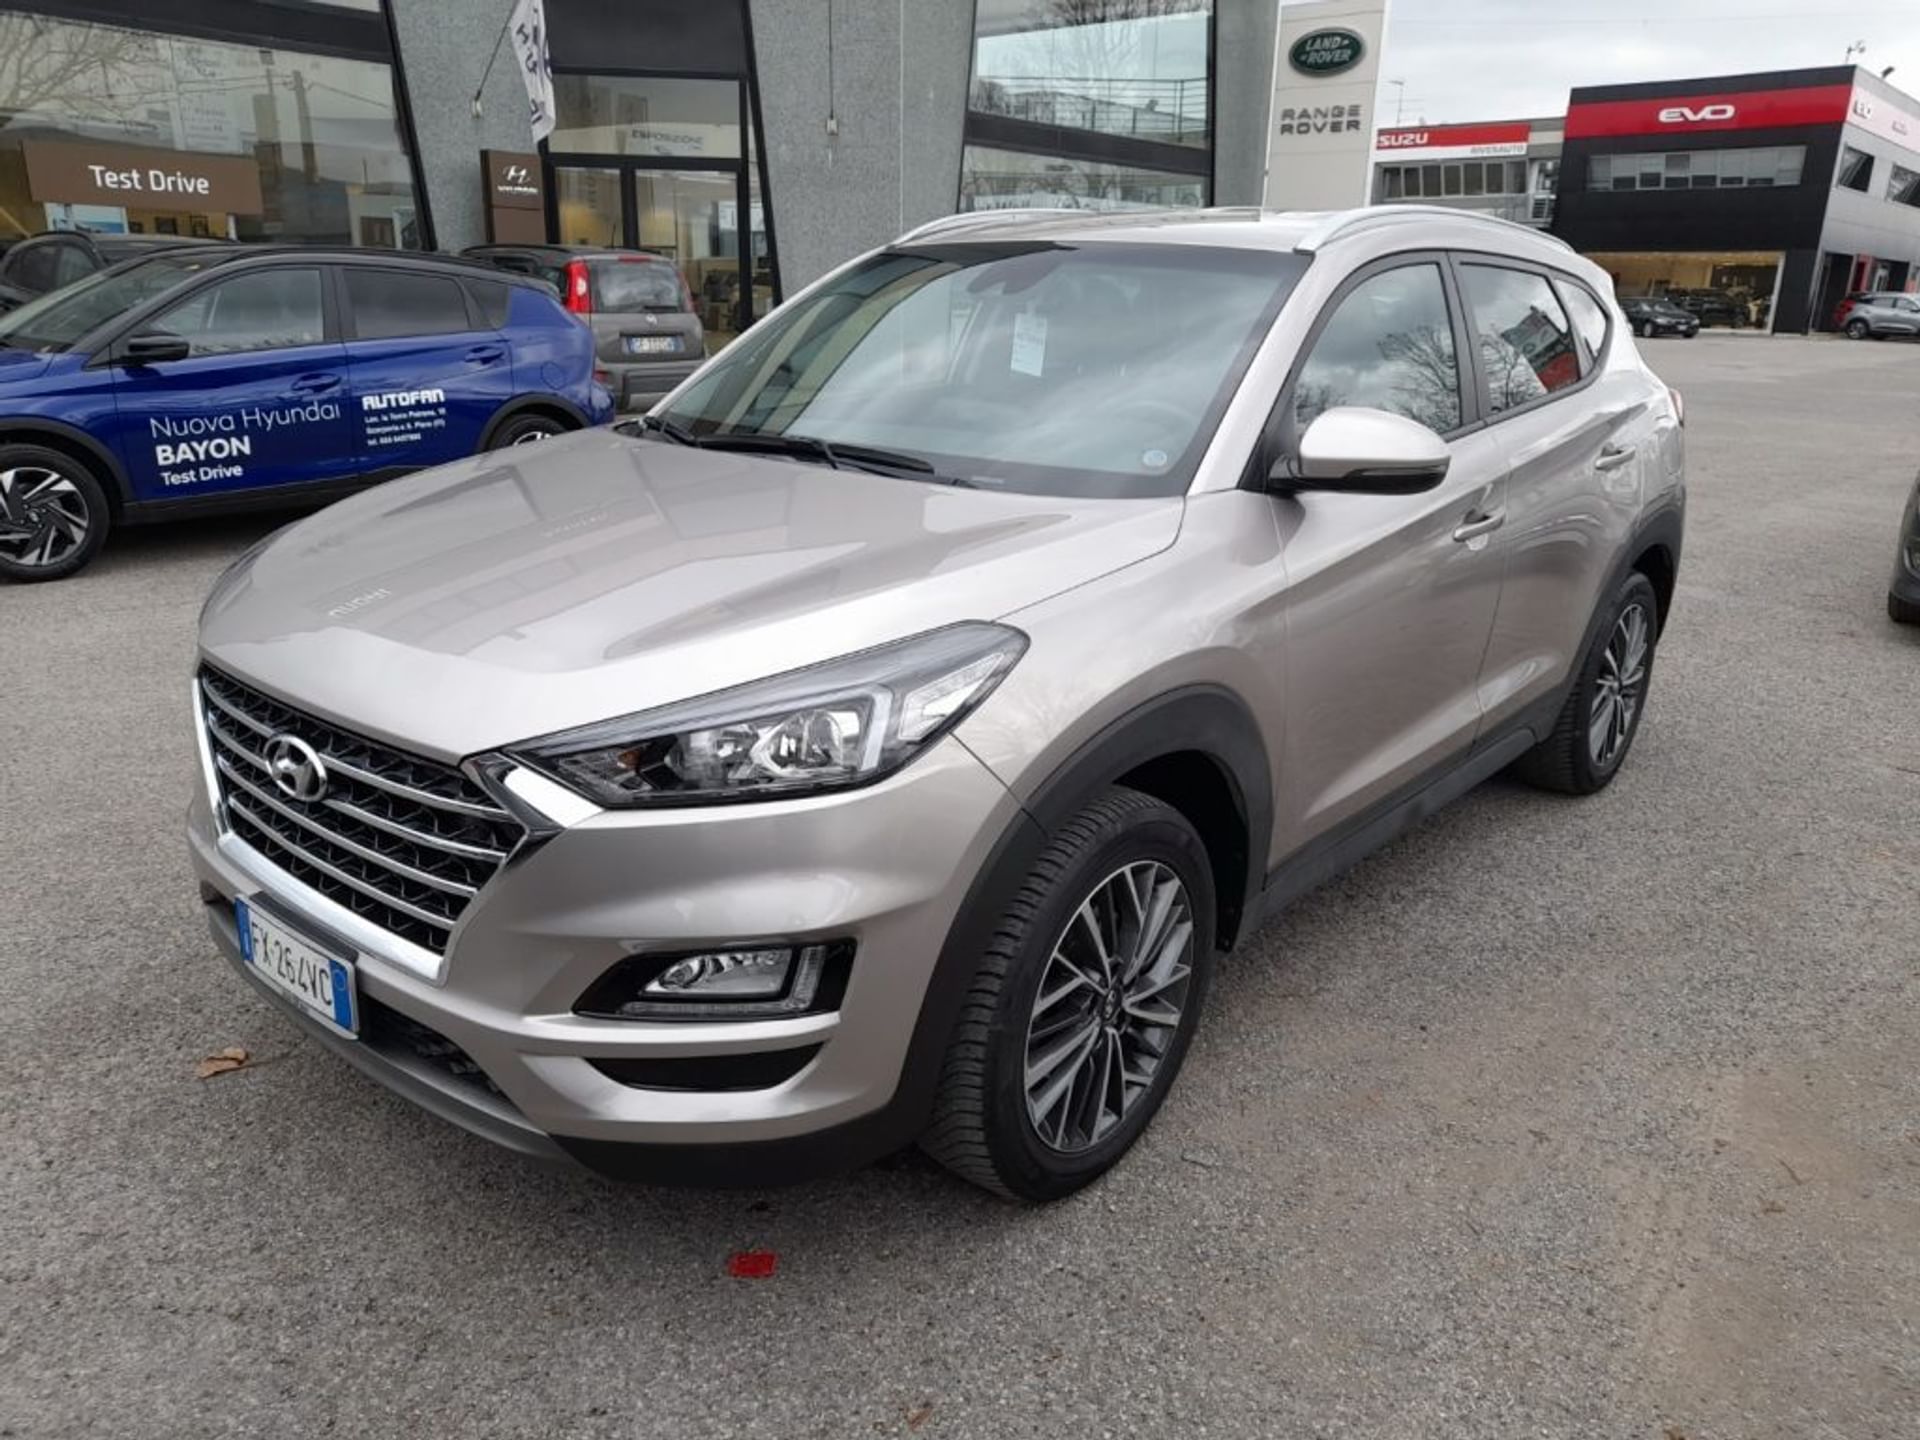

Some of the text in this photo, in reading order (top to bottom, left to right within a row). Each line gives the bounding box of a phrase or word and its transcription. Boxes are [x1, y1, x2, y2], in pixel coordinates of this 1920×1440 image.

[1305, 36, 1342, 52] LAND
[1306, 49, 1352, 65] ROVER
[1281, 104, 1362, 121] RANGE
[1659, 104, 1735, 123] EVO
[1280, 120, 1361, 136] ROVER
[88, 164, 210, 195] Test Drive
[362, 388, 445, 411] AUTOFAN
[150, 401, 342, 438] Nuova Hyundai
[155, 435, 251, 466] BAYON
[161, 463, 244, 486] Test Drive
